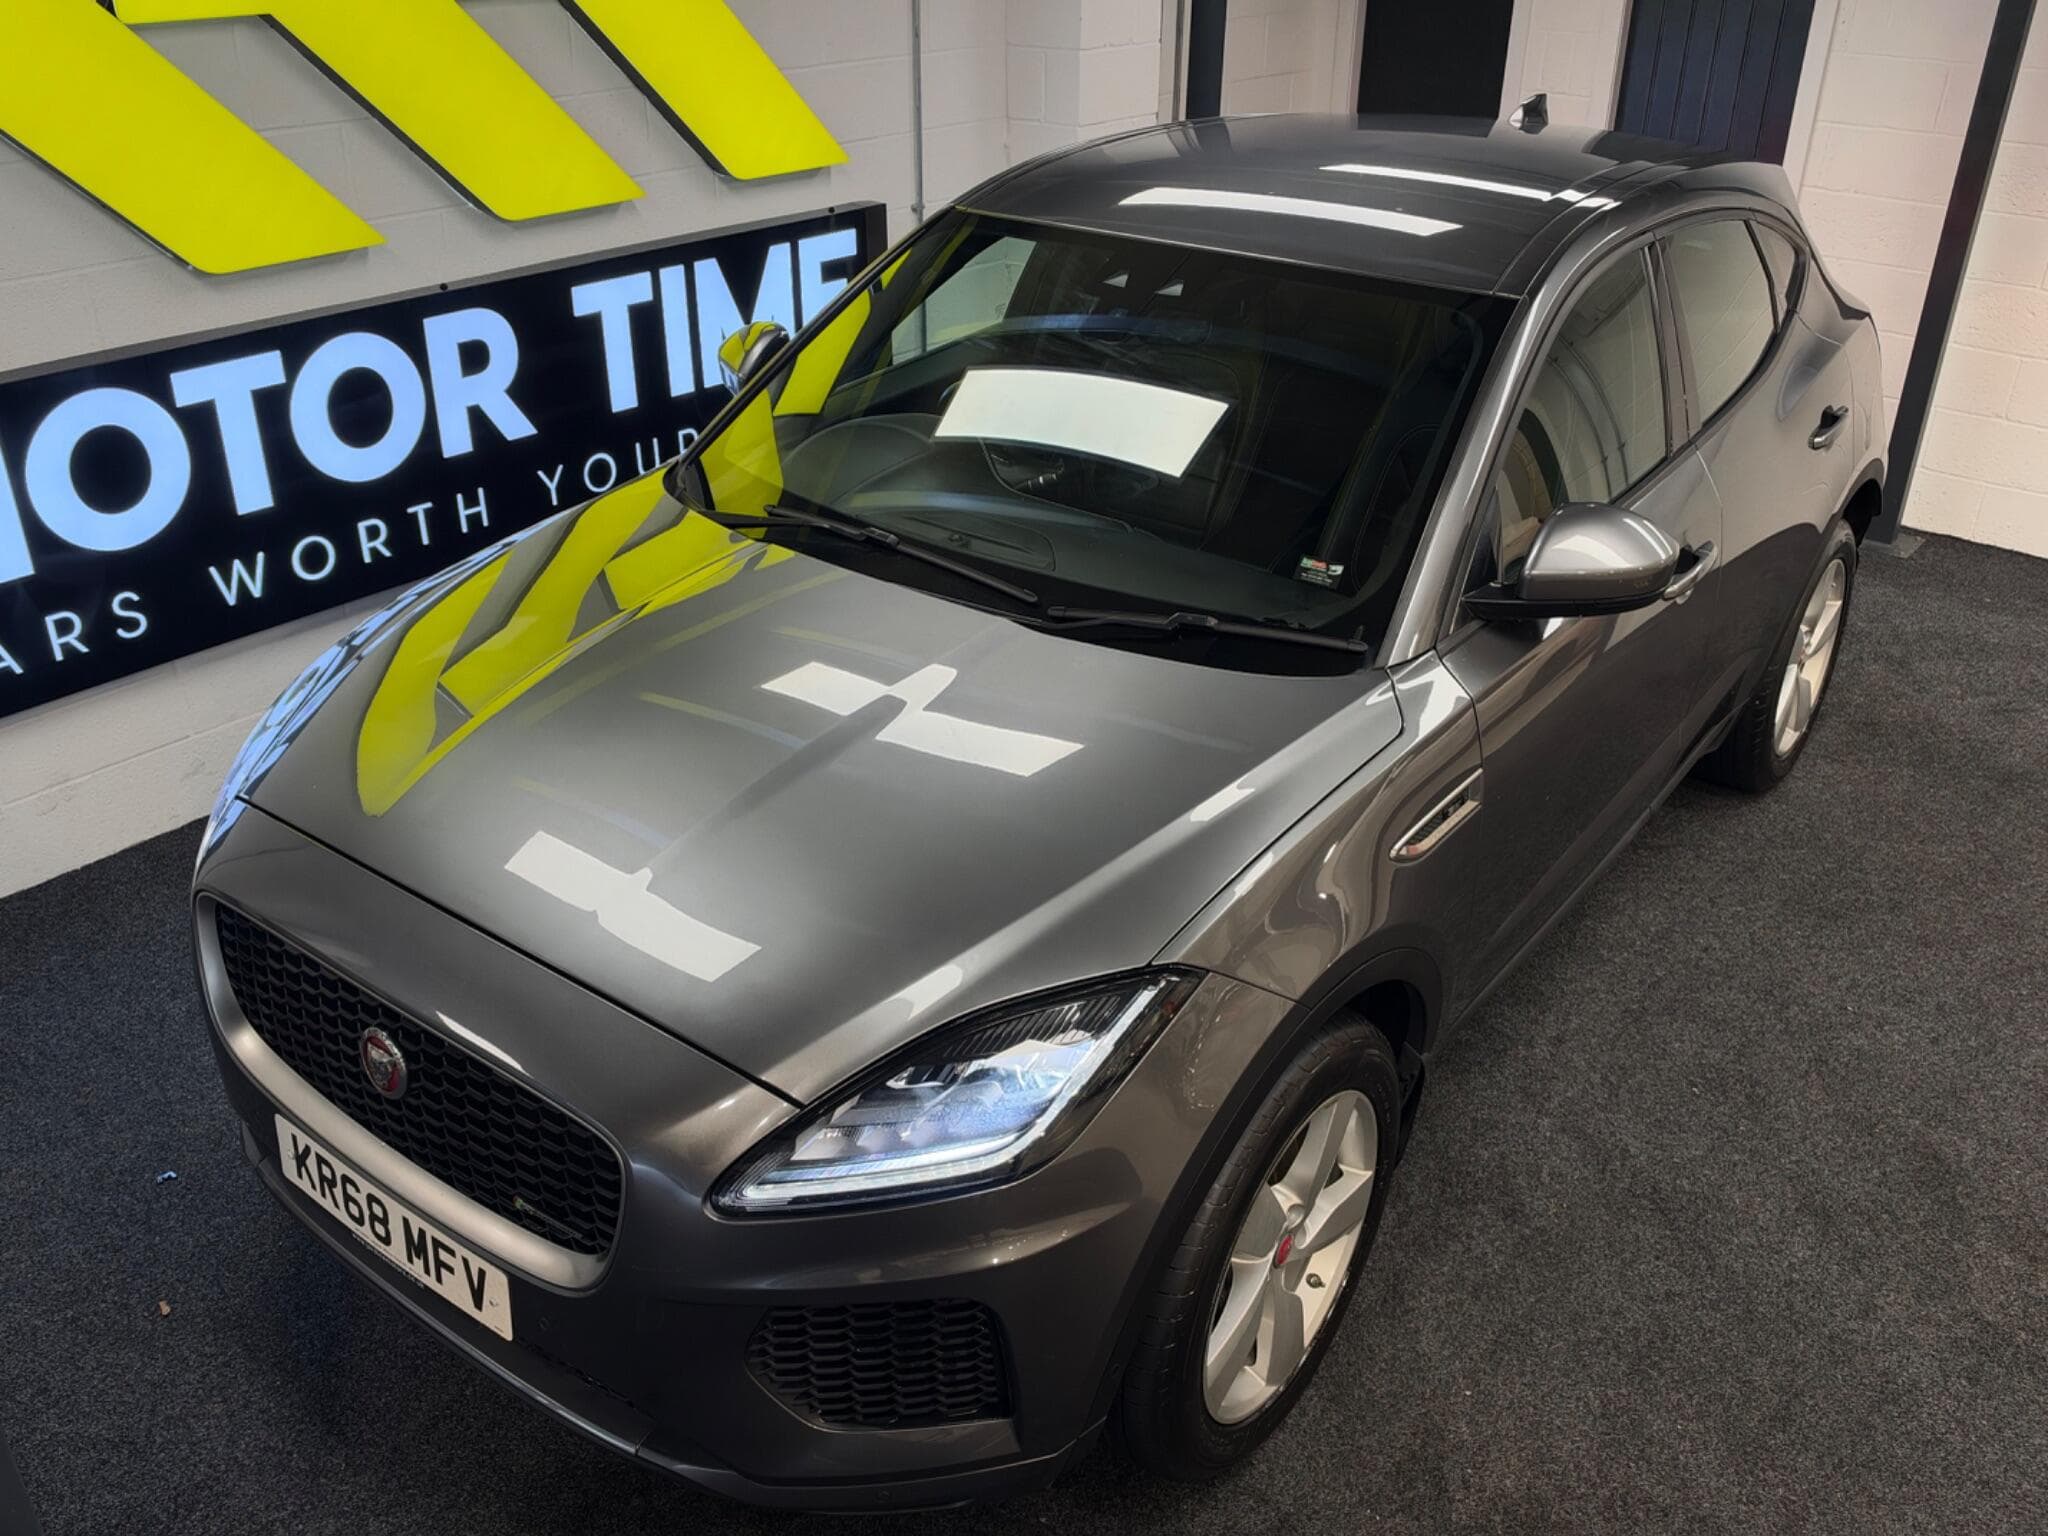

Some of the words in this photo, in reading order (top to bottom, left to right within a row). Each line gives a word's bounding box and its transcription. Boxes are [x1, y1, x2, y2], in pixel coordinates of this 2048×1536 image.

[0, 307, 538, 583] OTOR
[208, 487, 489, 606] WORTH
[290, 1132, 393, 1247] KR68
[402, 1215, 487, 1313] MFV
